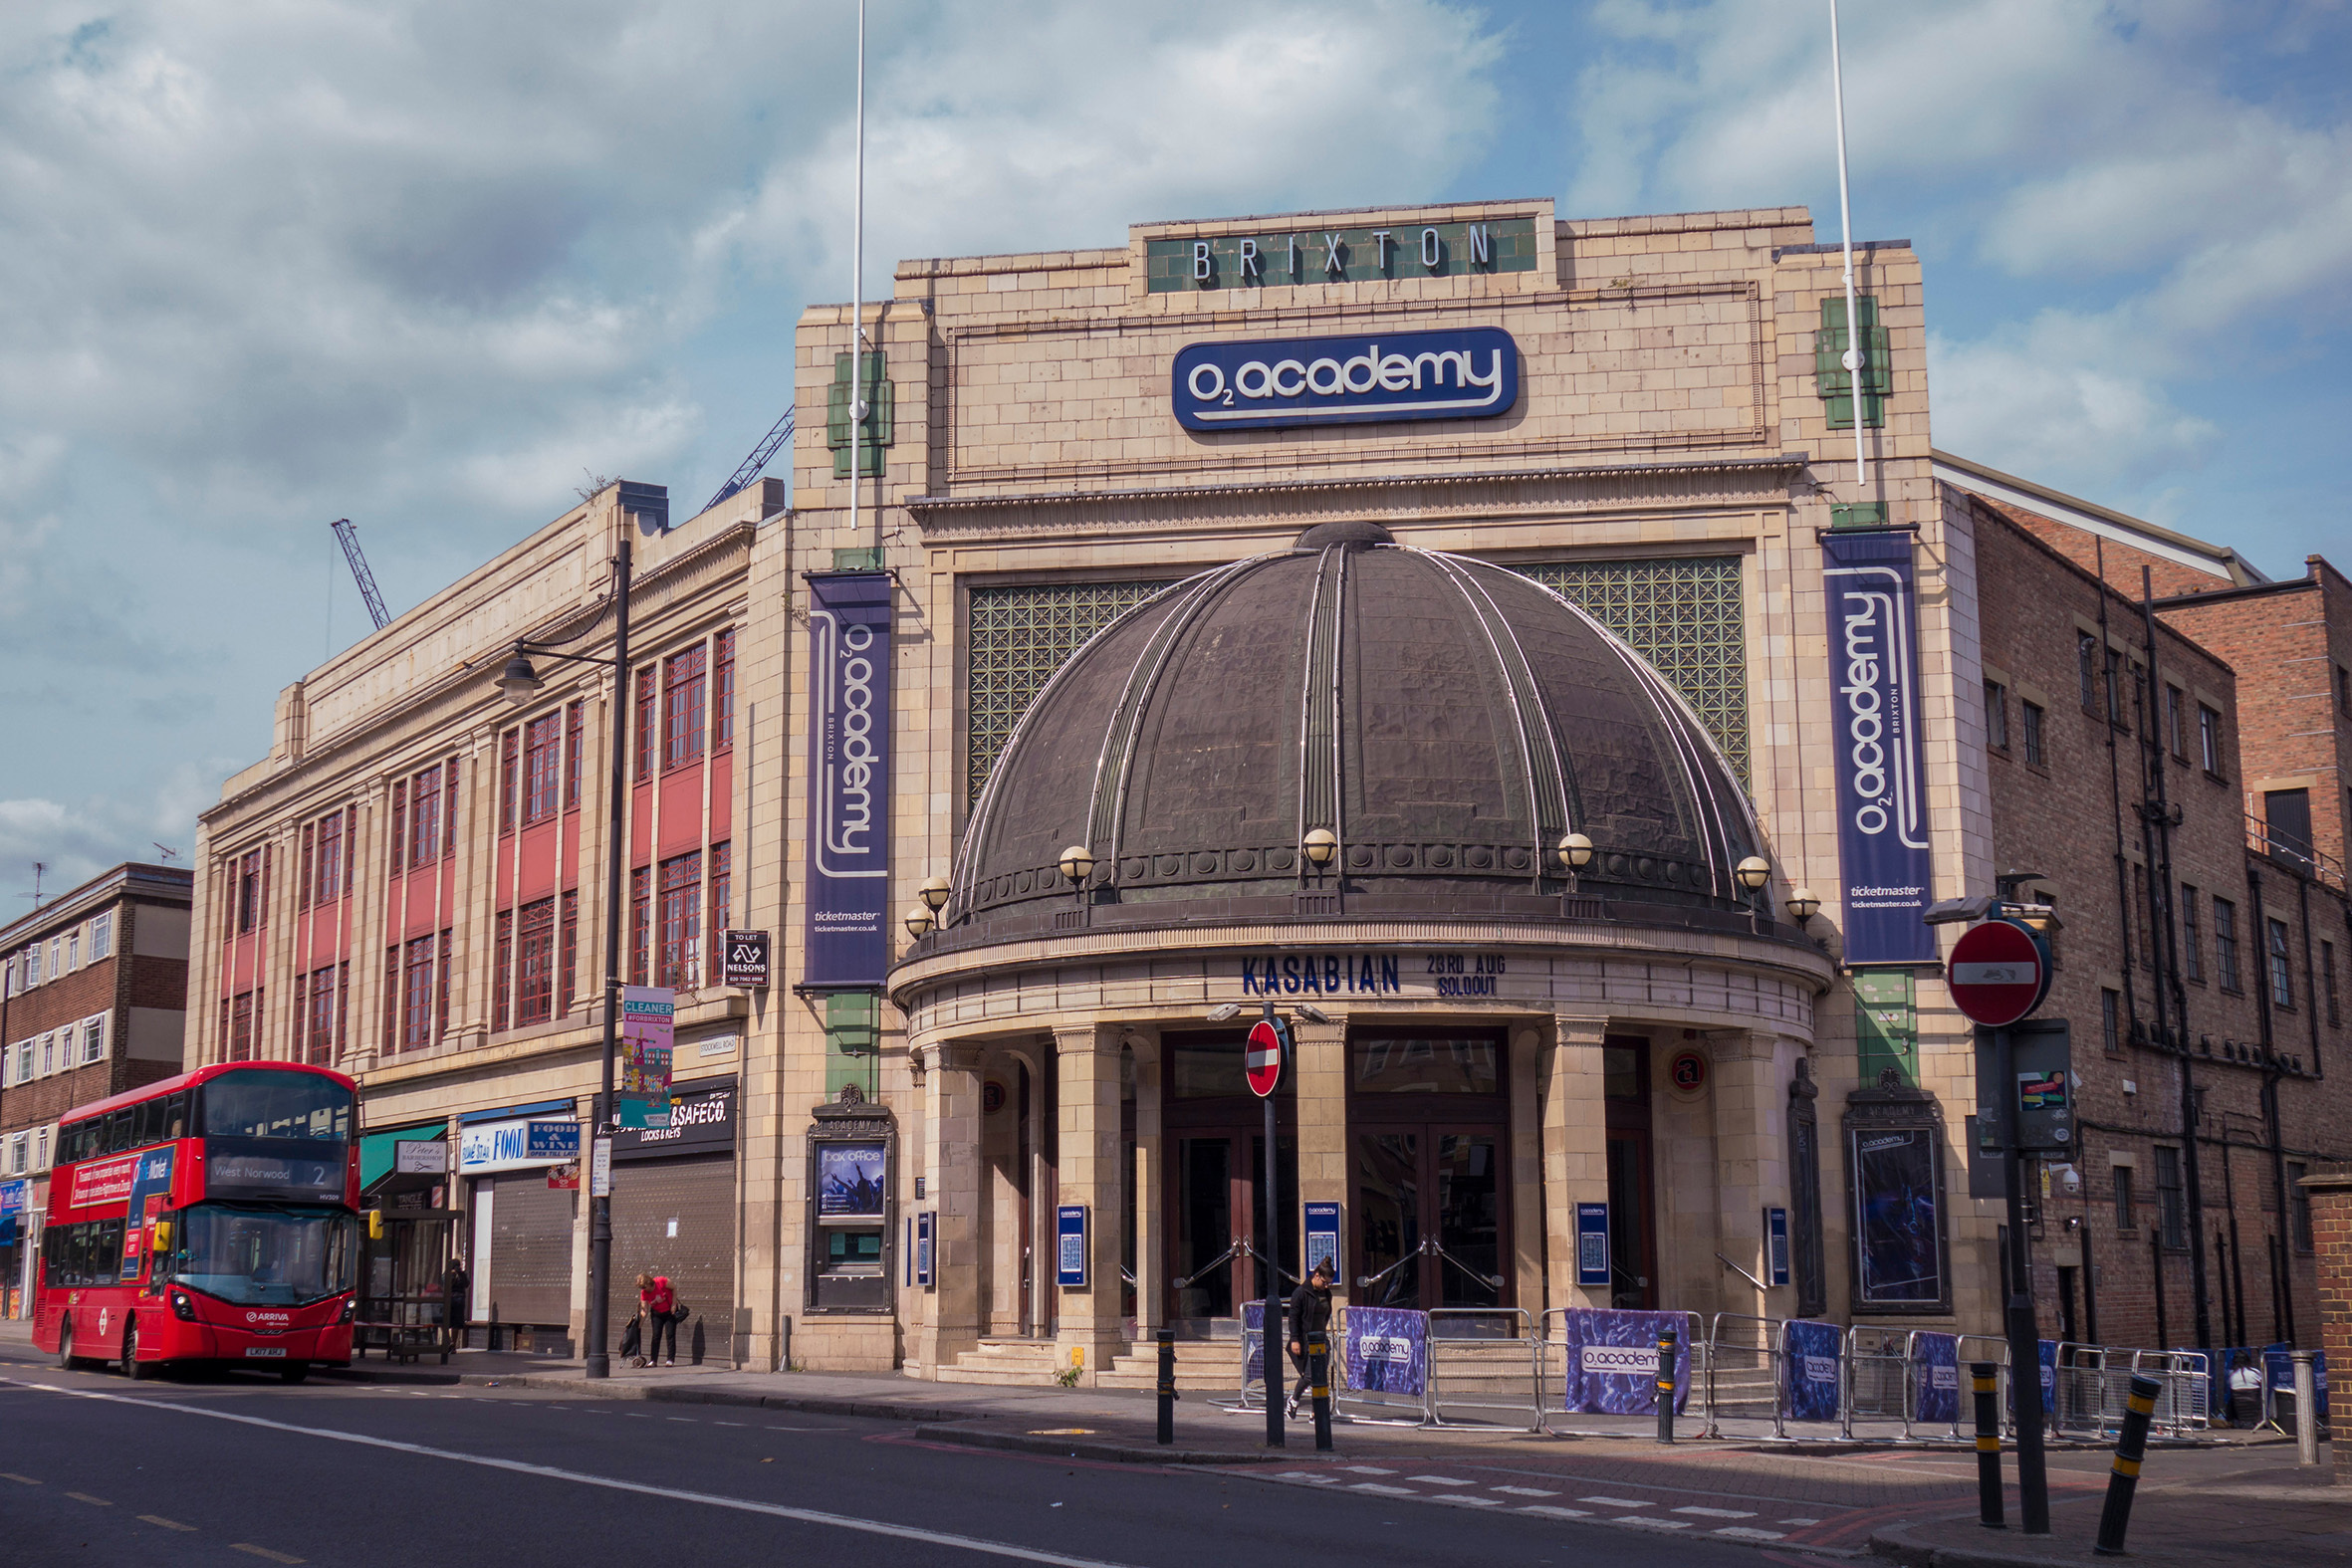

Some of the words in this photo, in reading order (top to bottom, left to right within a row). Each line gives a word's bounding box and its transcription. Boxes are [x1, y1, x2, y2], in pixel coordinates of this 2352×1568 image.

[1195, 224, 1489, 281] BRIXTON
[1891, 688, 1900, 734] BRIXTON
[1851, 886, 1921, 896] ticketmaster
[815, 911, 877, 921] ticketmaster
[727, 964, 766, 973] NELSONS
[1427, 955, 1465, 974] 23RD
[1476, 955, 1506, 973] AUG
[1242, 954, 1399, 995] KASABIAN
[1438, 976, 1497, 996] SOLDOUT
[624, 1002, 673, 1014] CLEANER
[627, 1014, 670, 1023] #FORBRIXTON
[723, 1039, 735, 1048] ROAD
[533, 1124, 578, 1133] FOOD
[828, 1120, 871, 1130] ACADEMY
[640, 1129, 660, 1142] LOCKS
[660, 1130, 665, 1140] &
[406, 1143, 440, 1154] Peter's
[823, 1151, 845, 1162] box
[848, 1150, 880, 1162] office
[214, 1165, 241, 1178] West
[244, 1167, 291, 1180] Norwood
[313, 1166, 325, 1186] 2
